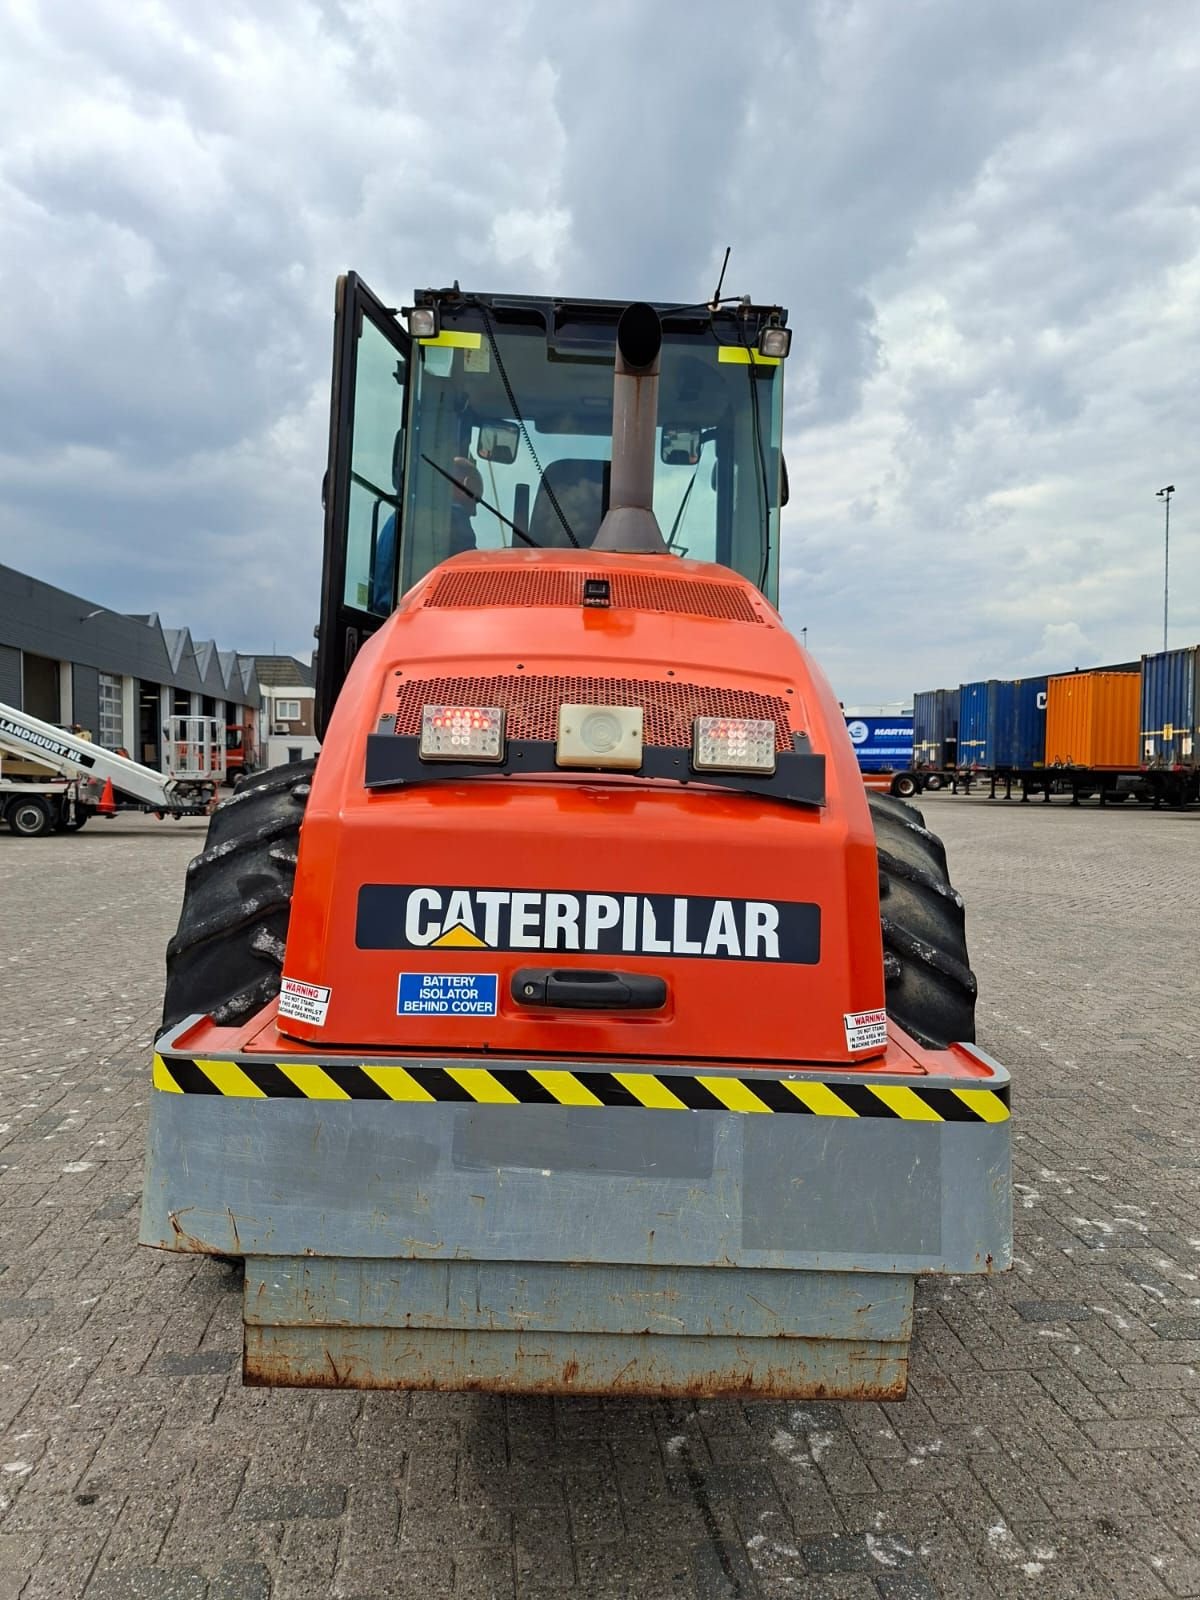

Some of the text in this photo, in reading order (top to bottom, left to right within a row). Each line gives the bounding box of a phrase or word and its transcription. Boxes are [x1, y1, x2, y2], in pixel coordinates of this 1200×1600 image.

[1037, 692, 1047, 709] C
[405, 888, 780, 959] CATERPILLAR
[423, 976, 476, 987] BATTERY
[286, 982, 319, 999] WARNING
[420, 989, 479, 999] ISOLATOR
[300, 999, 315, 1007] STAND
[404, 1001, 493, 1012] BEHIND COVER
[294, 1010, 320, 1022] OPERATING
[855, 1013, 885, 1025] WARNING
